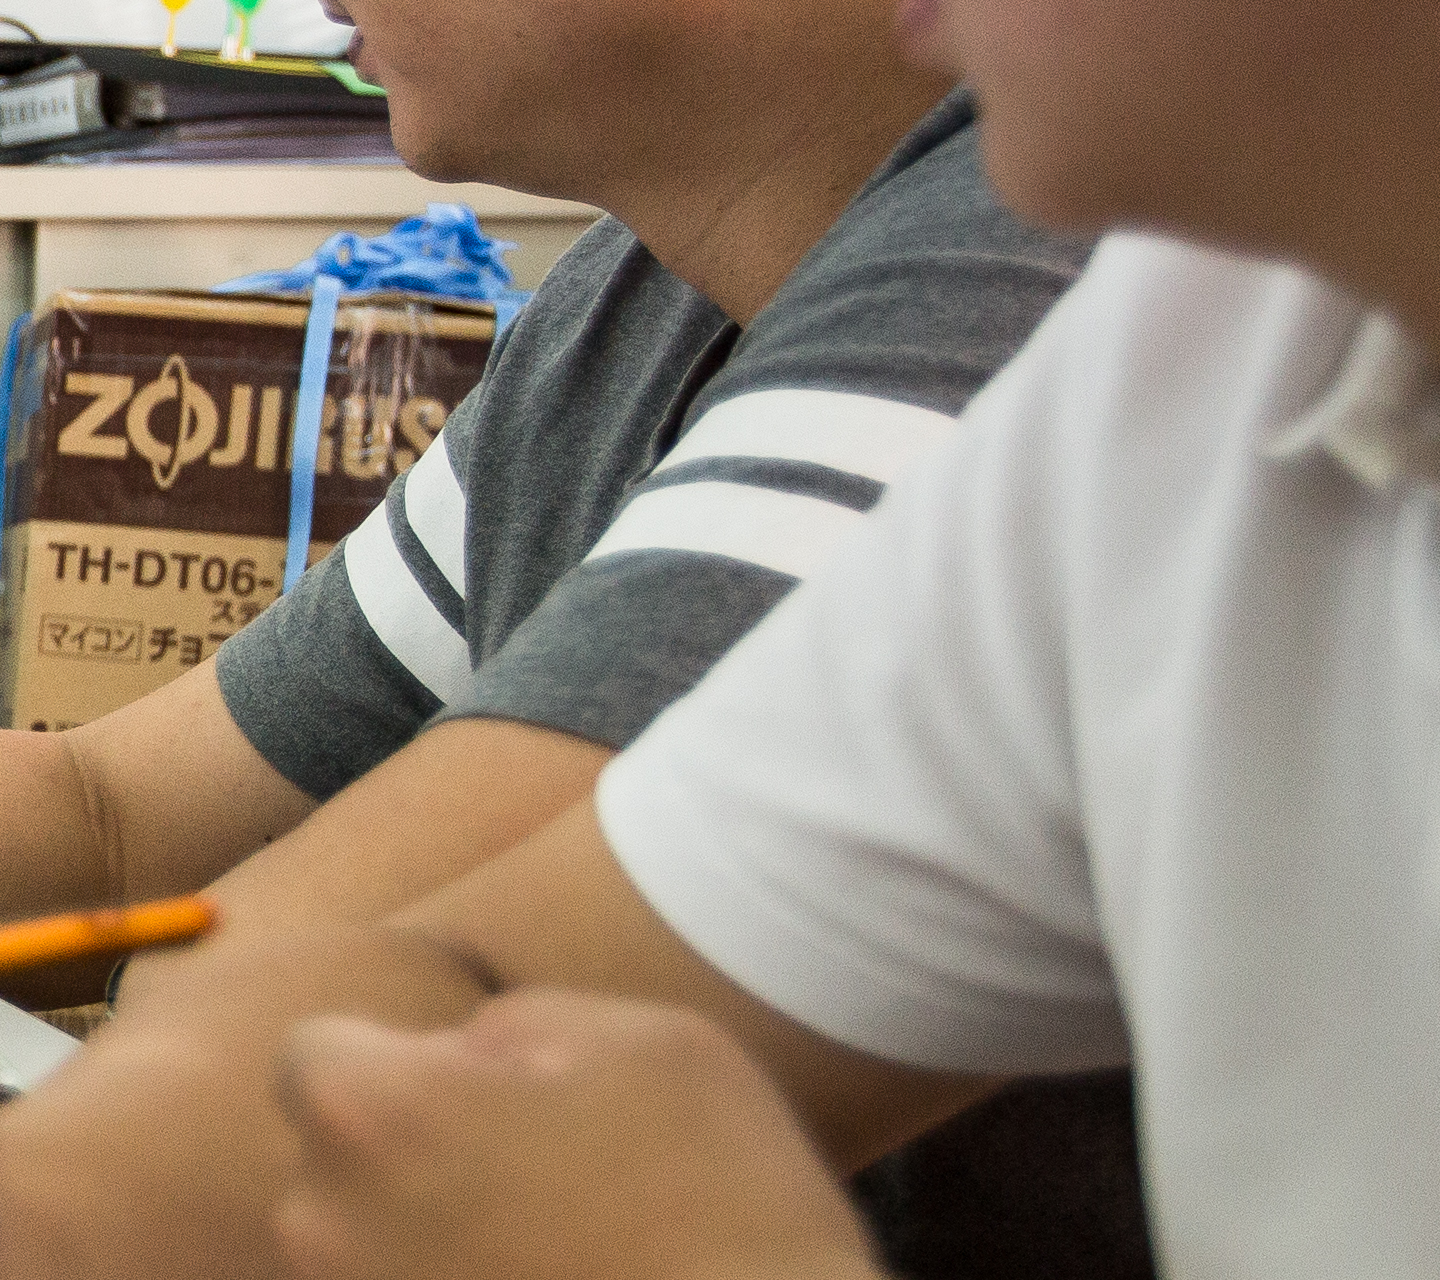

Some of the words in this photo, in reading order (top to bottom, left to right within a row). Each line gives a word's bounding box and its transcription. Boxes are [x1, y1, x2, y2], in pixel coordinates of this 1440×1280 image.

[48, 541, 286, 597] TH-DT06-
[46, 621, 136, 654] マイコン
